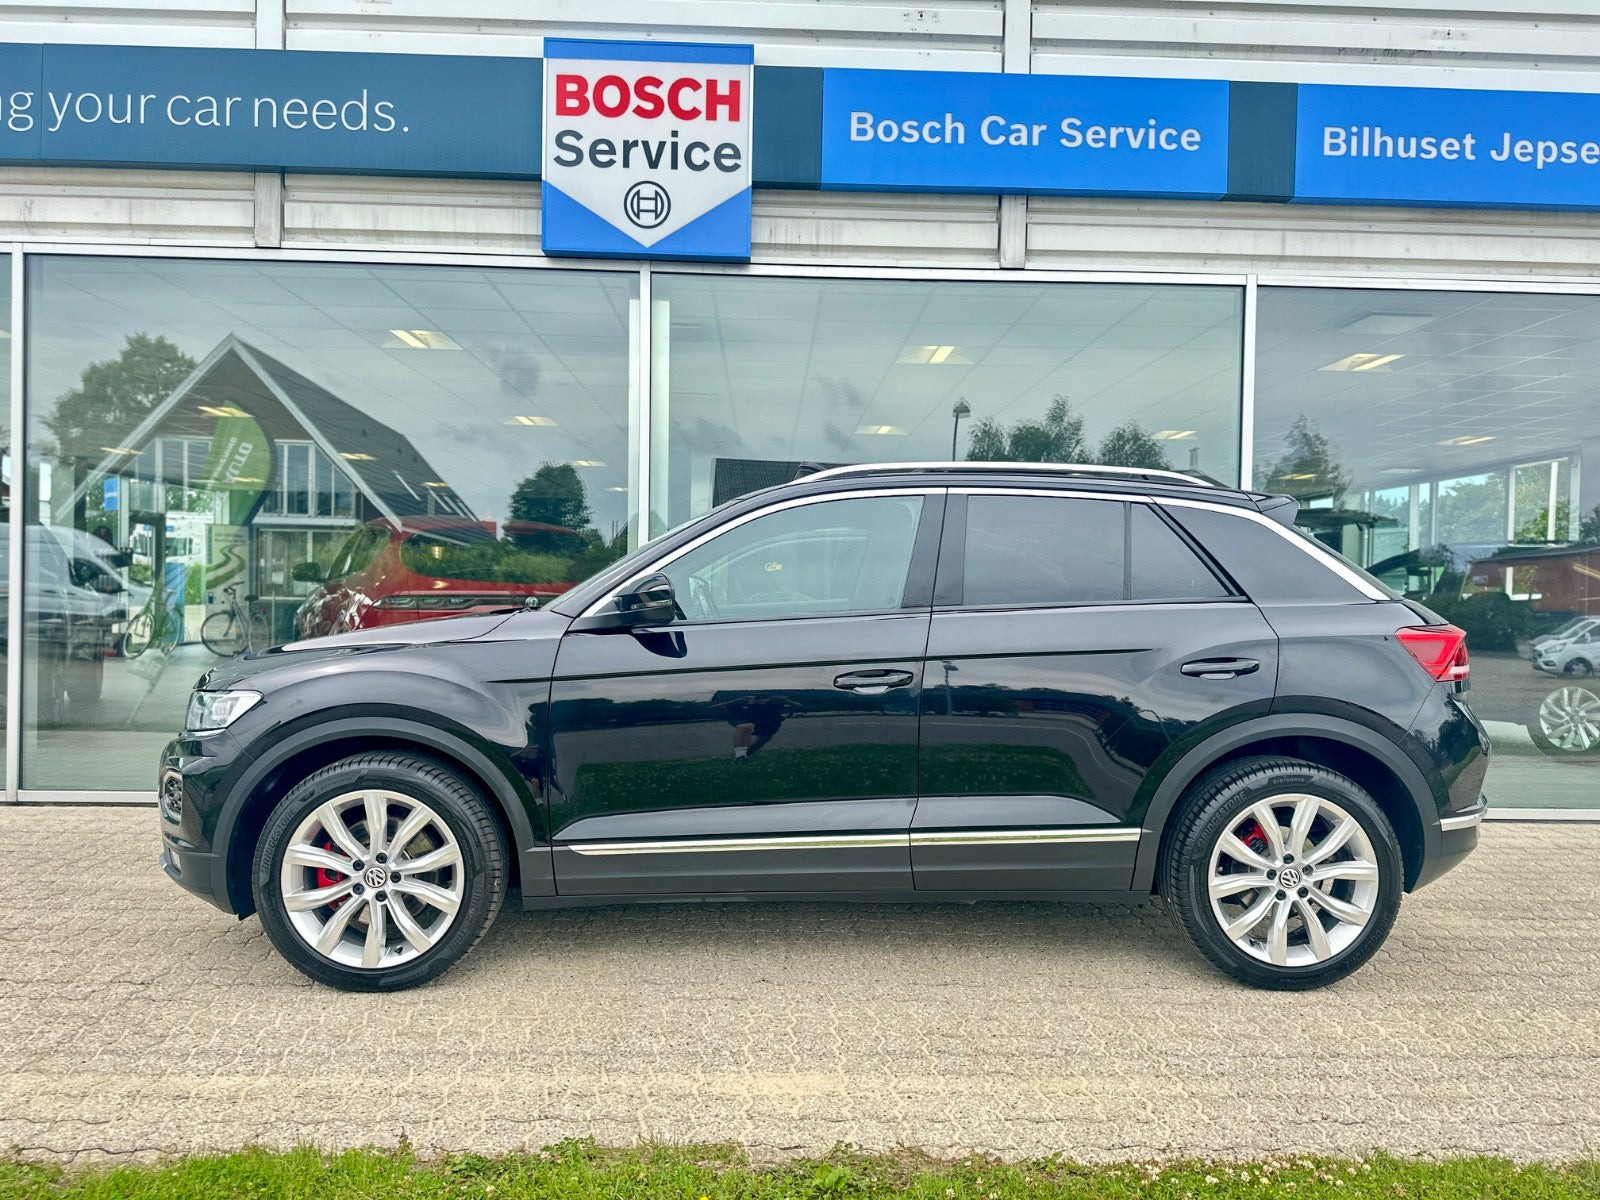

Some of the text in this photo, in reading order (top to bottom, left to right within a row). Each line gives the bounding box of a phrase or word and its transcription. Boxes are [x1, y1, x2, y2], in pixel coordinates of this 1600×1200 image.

[0, 89, 409, 133] g your car needs.
[555, 74, 742, 122] BOSCH
[553, 129, 743, 172] Service
[849, 110, 1202, 152] Bosch Car Service
[1322, 126, 1600, 170] Bilhuset Jepse
